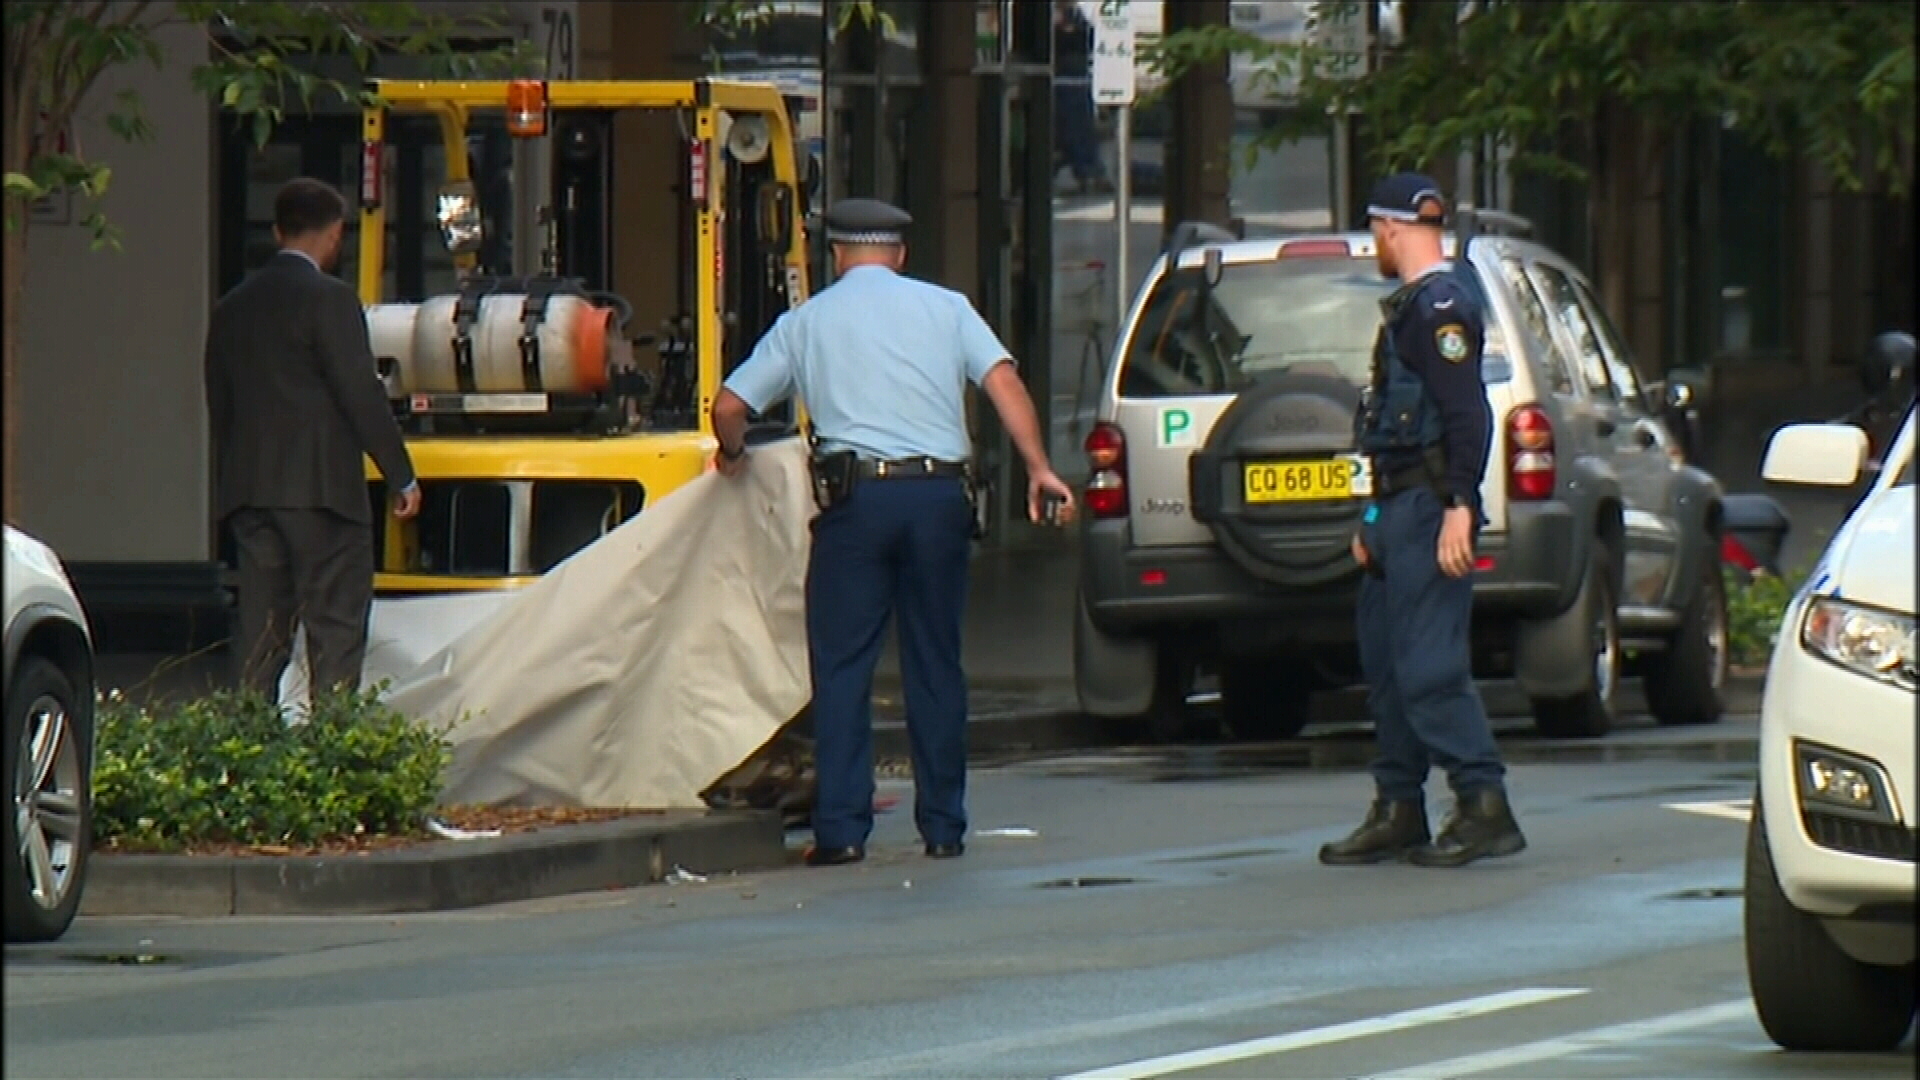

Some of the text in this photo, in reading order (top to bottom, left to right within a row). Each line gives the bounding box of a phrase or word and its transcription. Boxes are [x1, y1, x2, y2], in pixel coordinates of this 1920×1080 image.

[543, 8, 573, 80] 79
[1163, 409, 1190, 444] P
[1249, 463, 1347, 493] CQ 68 US
[1140, 498, 1185, 515] Jeep
